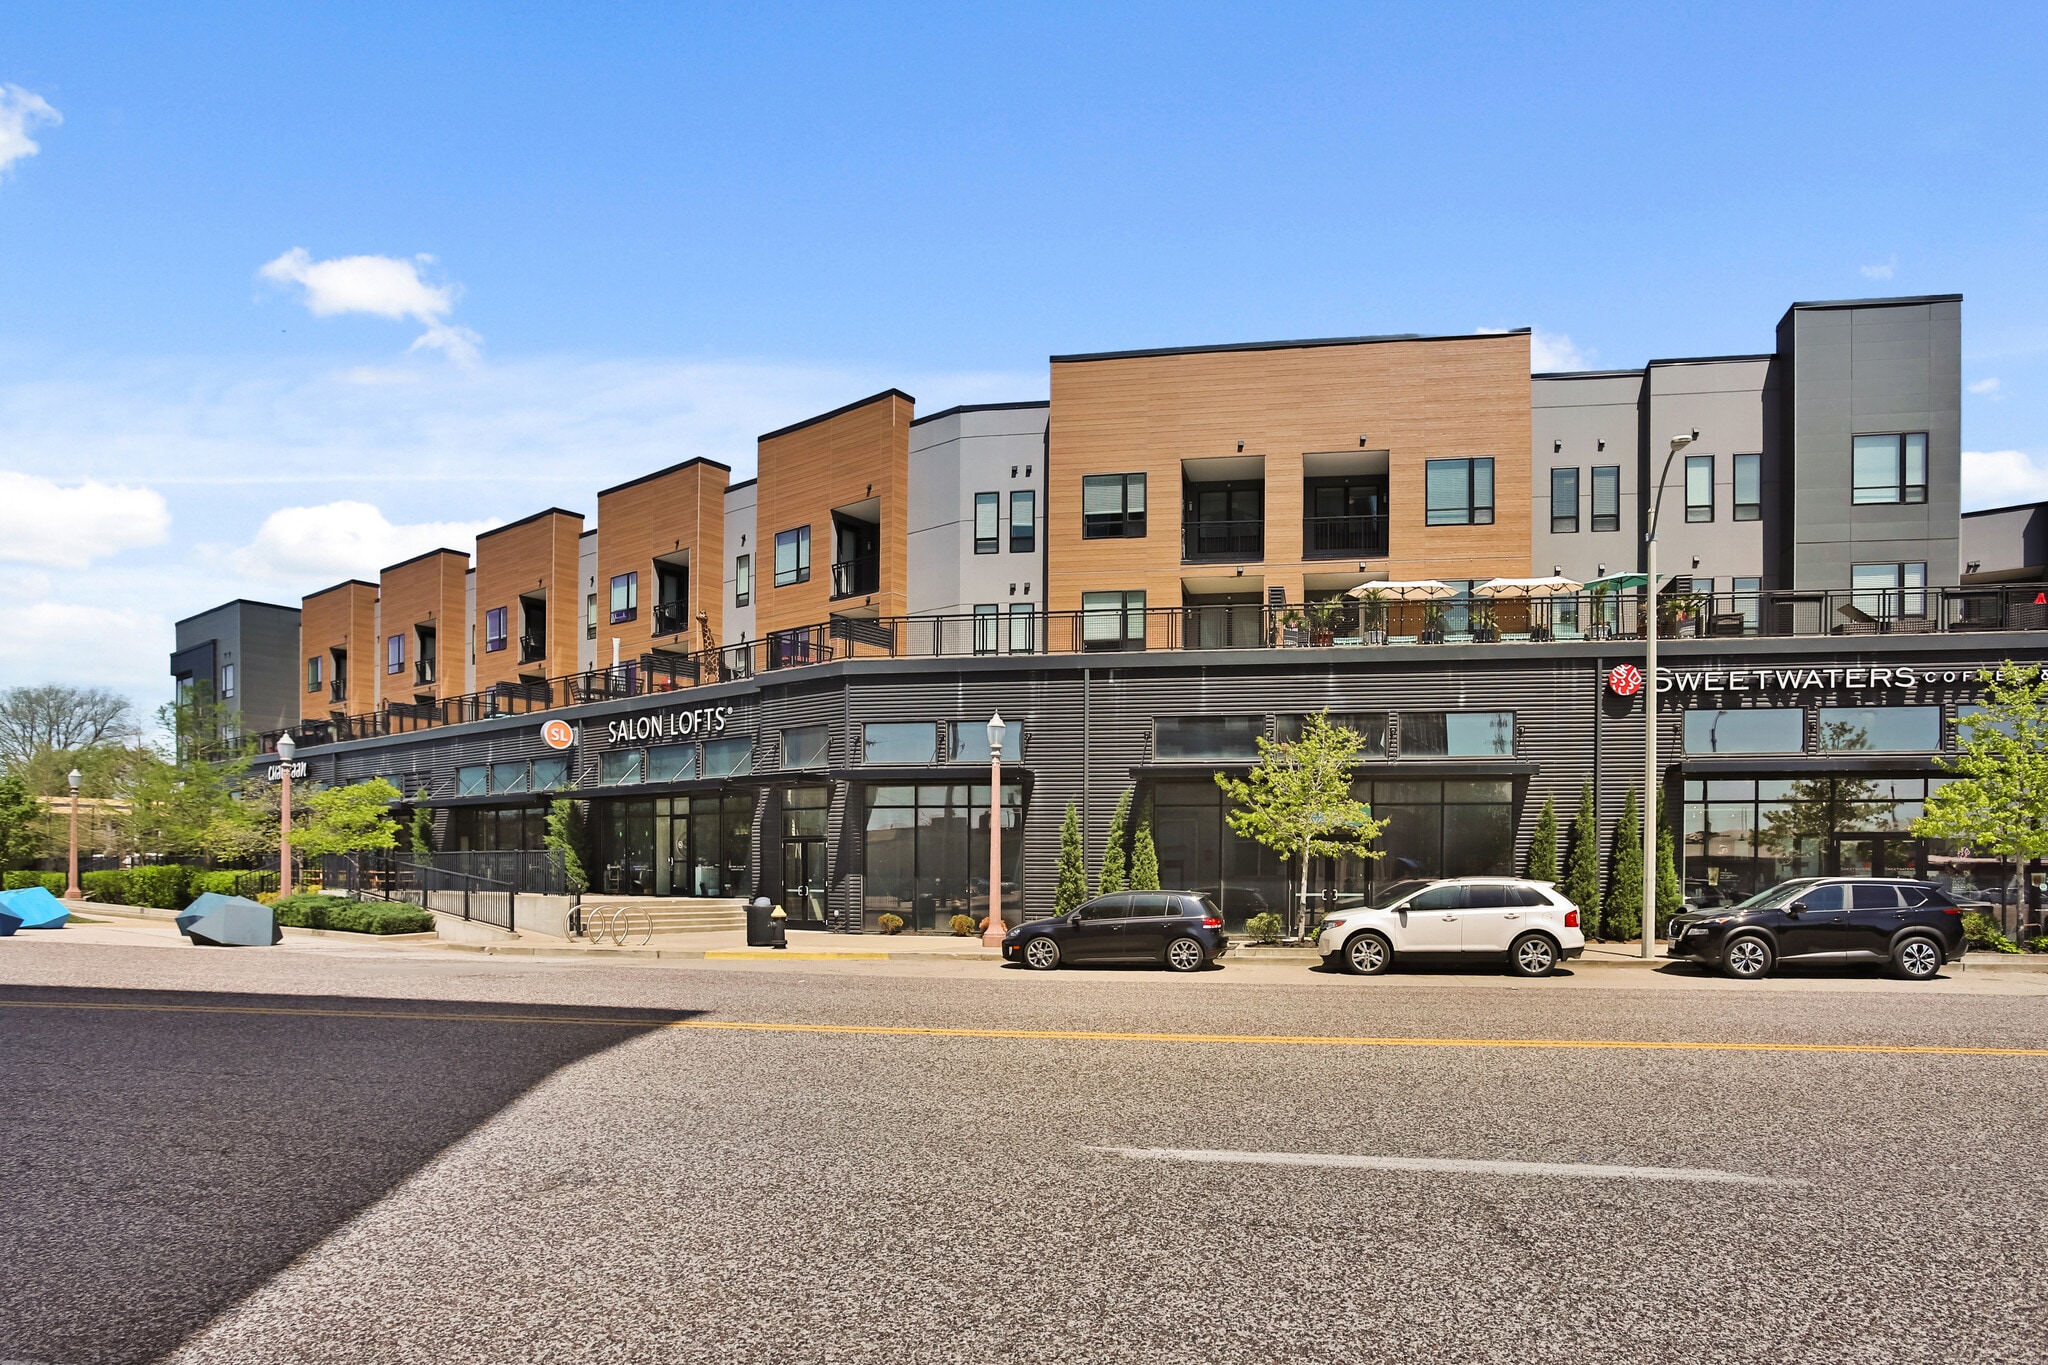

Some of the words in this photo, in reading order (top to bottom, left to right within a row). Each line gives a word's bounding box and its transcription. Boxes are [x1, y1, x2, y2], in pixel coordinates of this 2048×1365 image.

[1656, 667, 1915, 692] SWEETWATERS
[1925, 670, 2021, 683] COFE
[551, 727, 569, 742] SL
[608, 715, 663, 743] SALON
